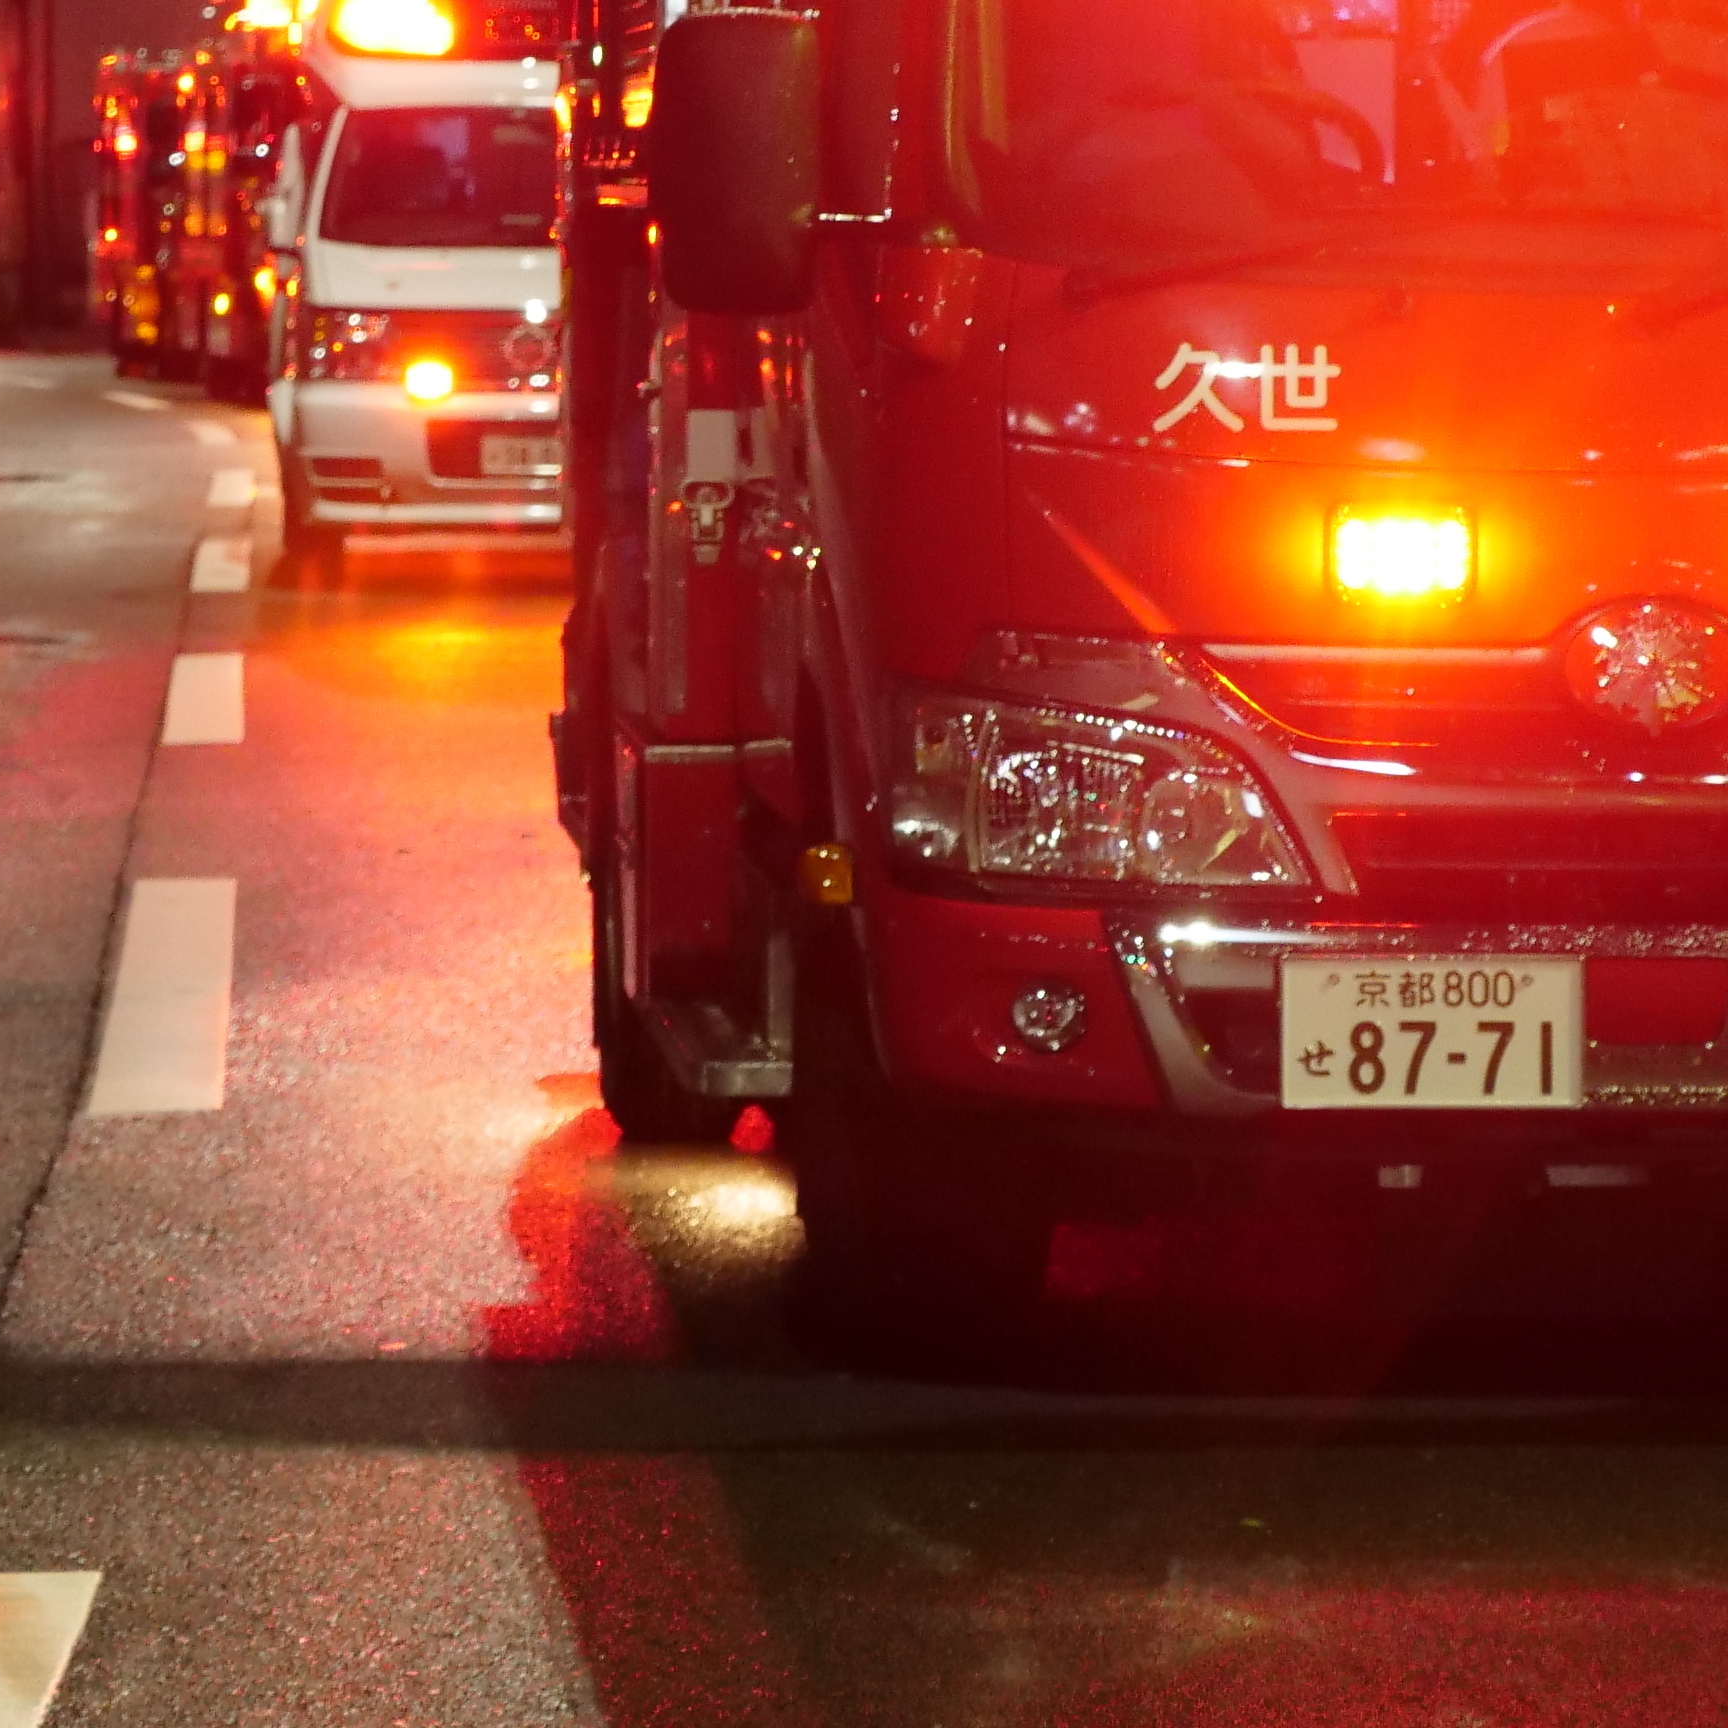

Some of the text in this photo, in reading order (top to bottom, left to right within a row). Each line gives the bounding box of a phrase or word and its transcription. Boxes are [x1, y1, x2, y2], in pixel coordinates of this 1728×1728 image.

[1152, 342, 1341, 433] 久世
[1298, 1020, 1553, 1095] せ 87-71
